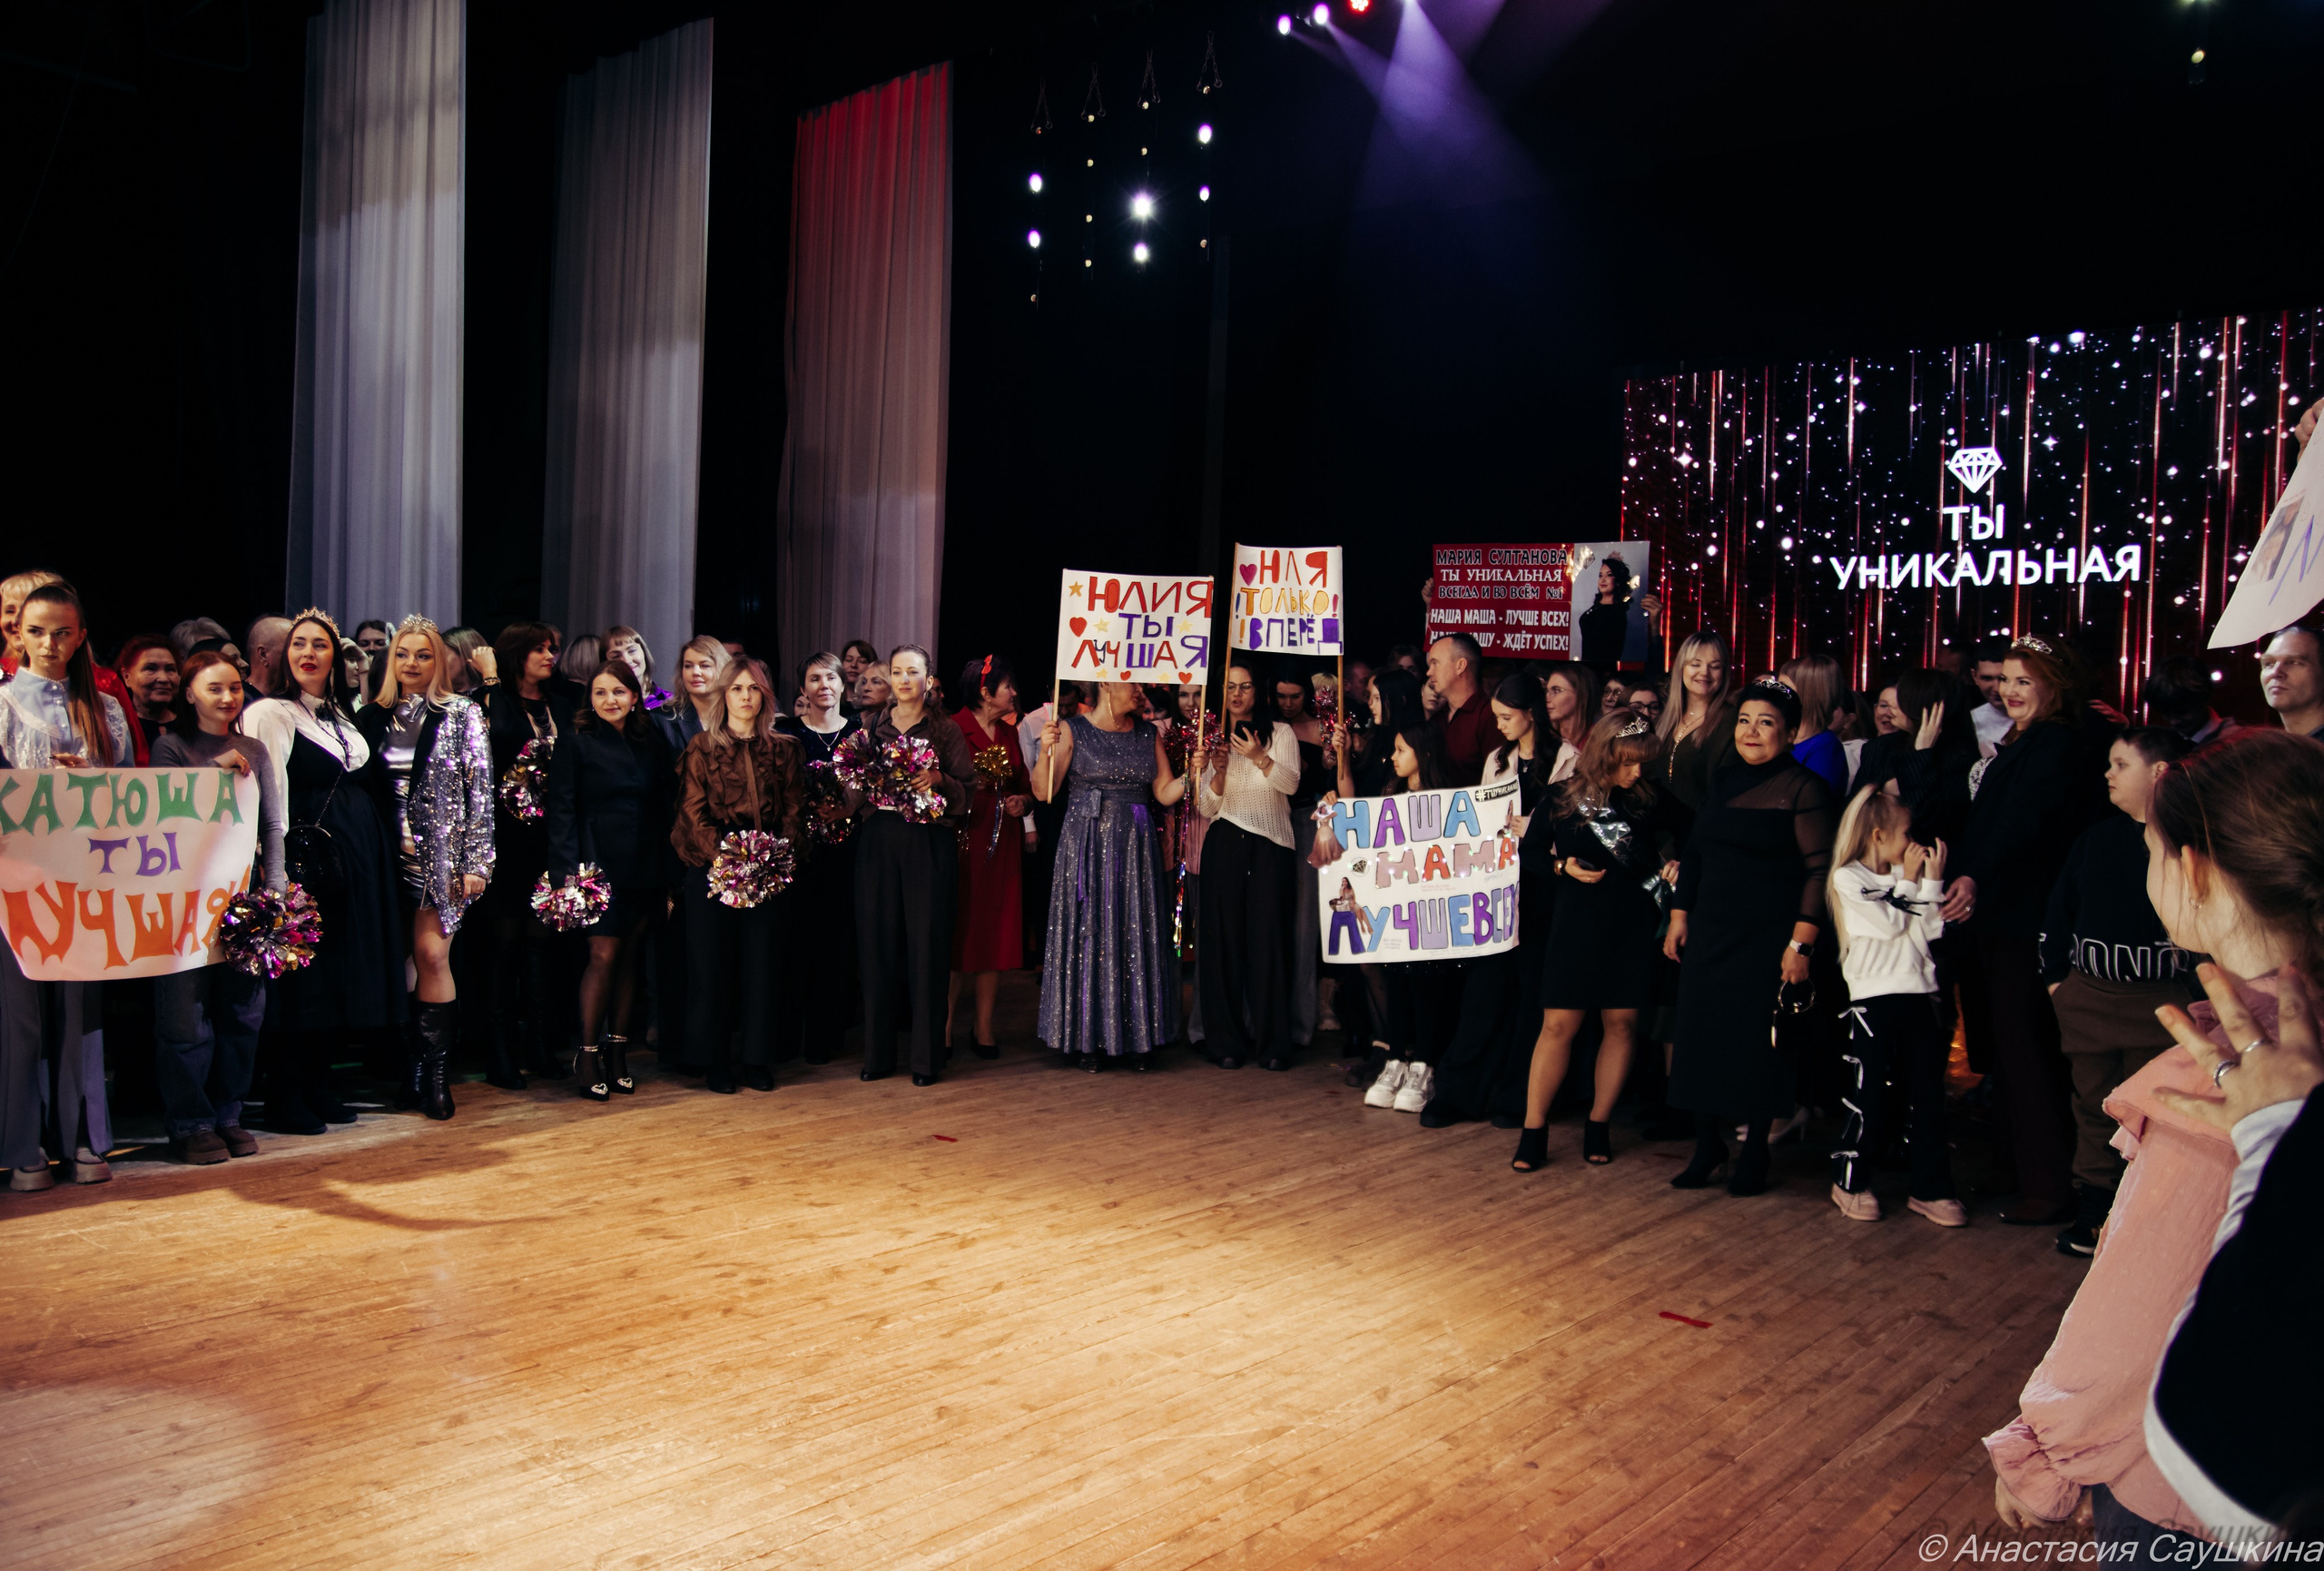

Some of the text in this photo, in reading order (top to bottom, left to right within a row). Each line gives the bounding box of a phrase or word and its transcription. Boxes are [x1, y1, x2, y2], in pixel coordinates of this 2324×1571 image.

[1943, 504, 2004, 540] ТЫ
[1436, 548, 1568, 565] МАРИЯ СУЛТАНОВА
[1829, 545, 2142, 590] УНИКАЛЬНАЯ
[1438, 586, 1480, 599] ВСЕГДА
[1482, 586, 1490, 598] И
[1493, 586, 1507, 598] ВО
[1510, 583, 1540, 599] ВСЁМ
[1441, 569, 1562, 582] ТЫ УНИКАЛЬНАЯ
[1088, 576, 1214, 618] ЮЛИЯ
[1118, 612, 1175, 639] ТЫ
[1430, 609, 1461, 624] НАША
[1463, 609, 1496, 625] МАША
[1505, 610, 1541, 626] ЛУЧШЕ
[1542, 611, 1570, 627] ВСЕХ!
[1070, 635, 1208, 669] ЛУЧШАЯ
[1502, 630, 1532, 651] ЖДЁТ
[1533, 634, 1569, 651] УСПЕХ!
[1333, 791, 1482, 851] НАША
[87, 832, 182, 876] ТЫ
[1375, 837, 1514, 889] МАМА
